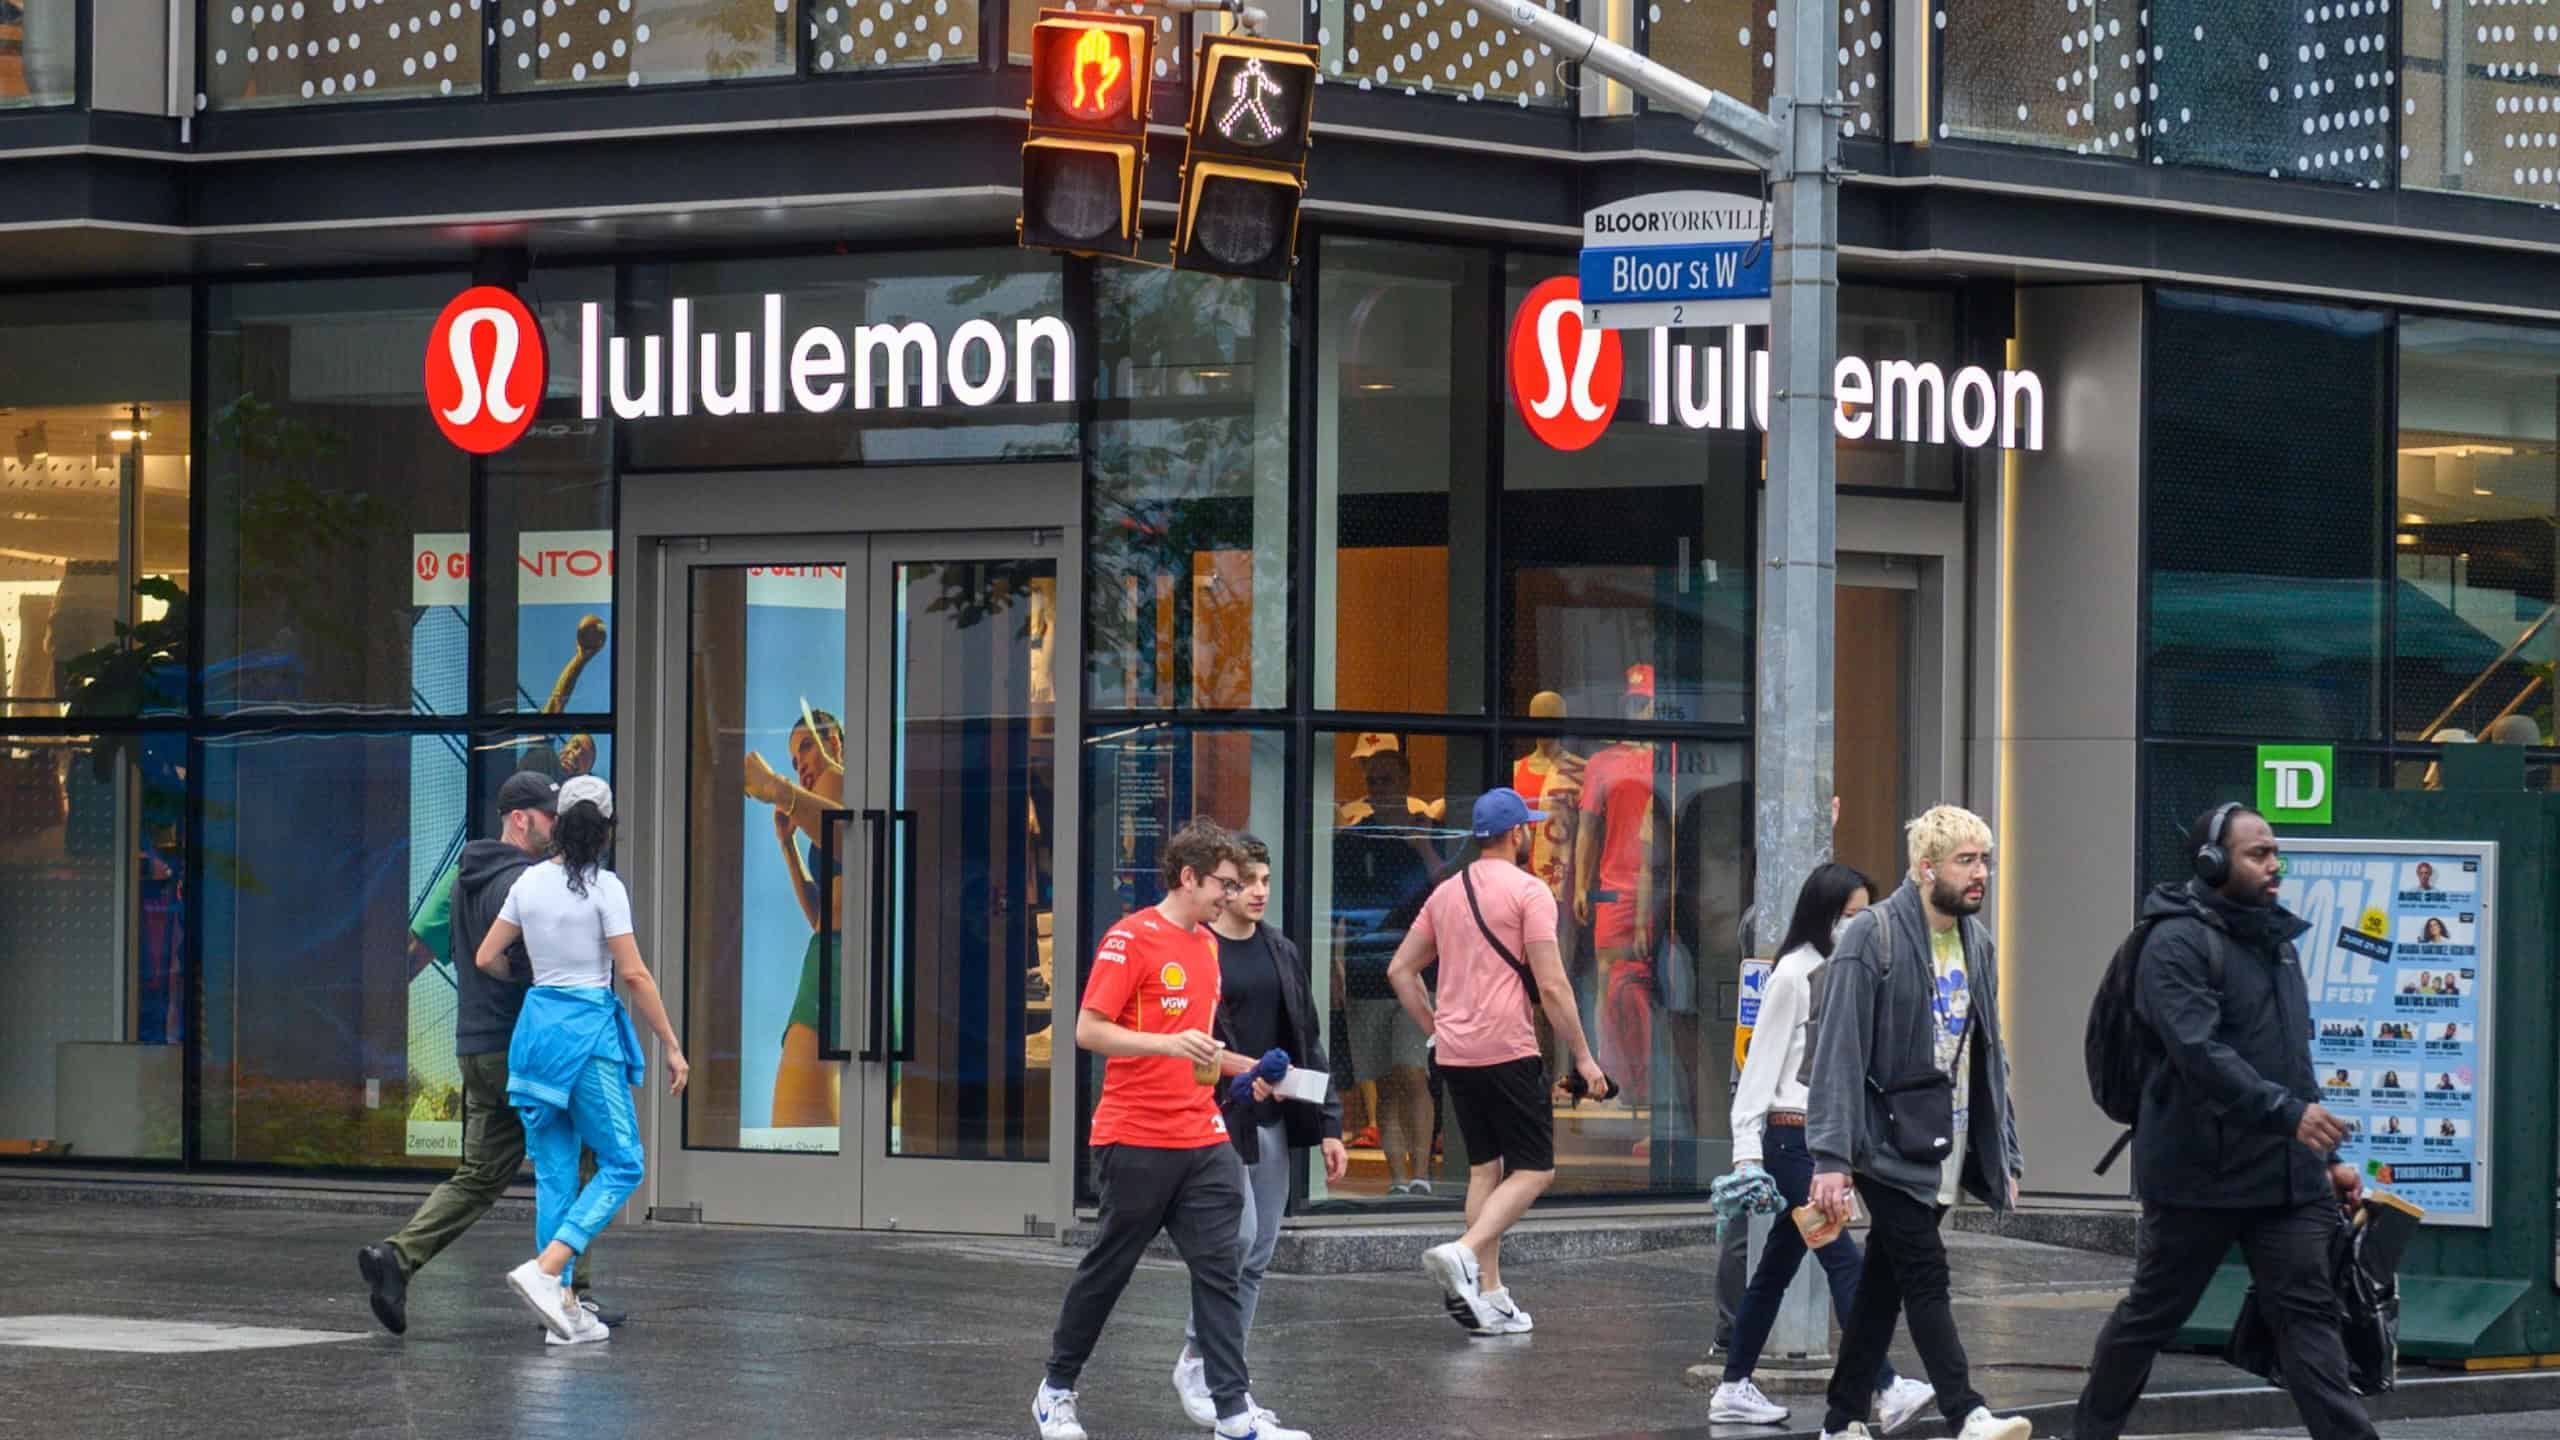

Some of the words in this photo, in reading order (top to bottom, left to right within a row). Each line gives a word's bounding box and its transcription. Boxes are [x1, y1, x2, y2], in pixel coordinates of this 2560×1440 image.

[1613, 255, 1683, 292] Bloor
[1688, 260, 1709, 289] St
[1715, 252, 1738, 288] W
[1673, 305, 1683, 324] 2
[581, 294, 1074, 419] lululemon
[1649, 324, 2044, 450] lulemon
[2264, 760, 2325, 808] TD
[2326, 988, 2376, 1003] FEST
